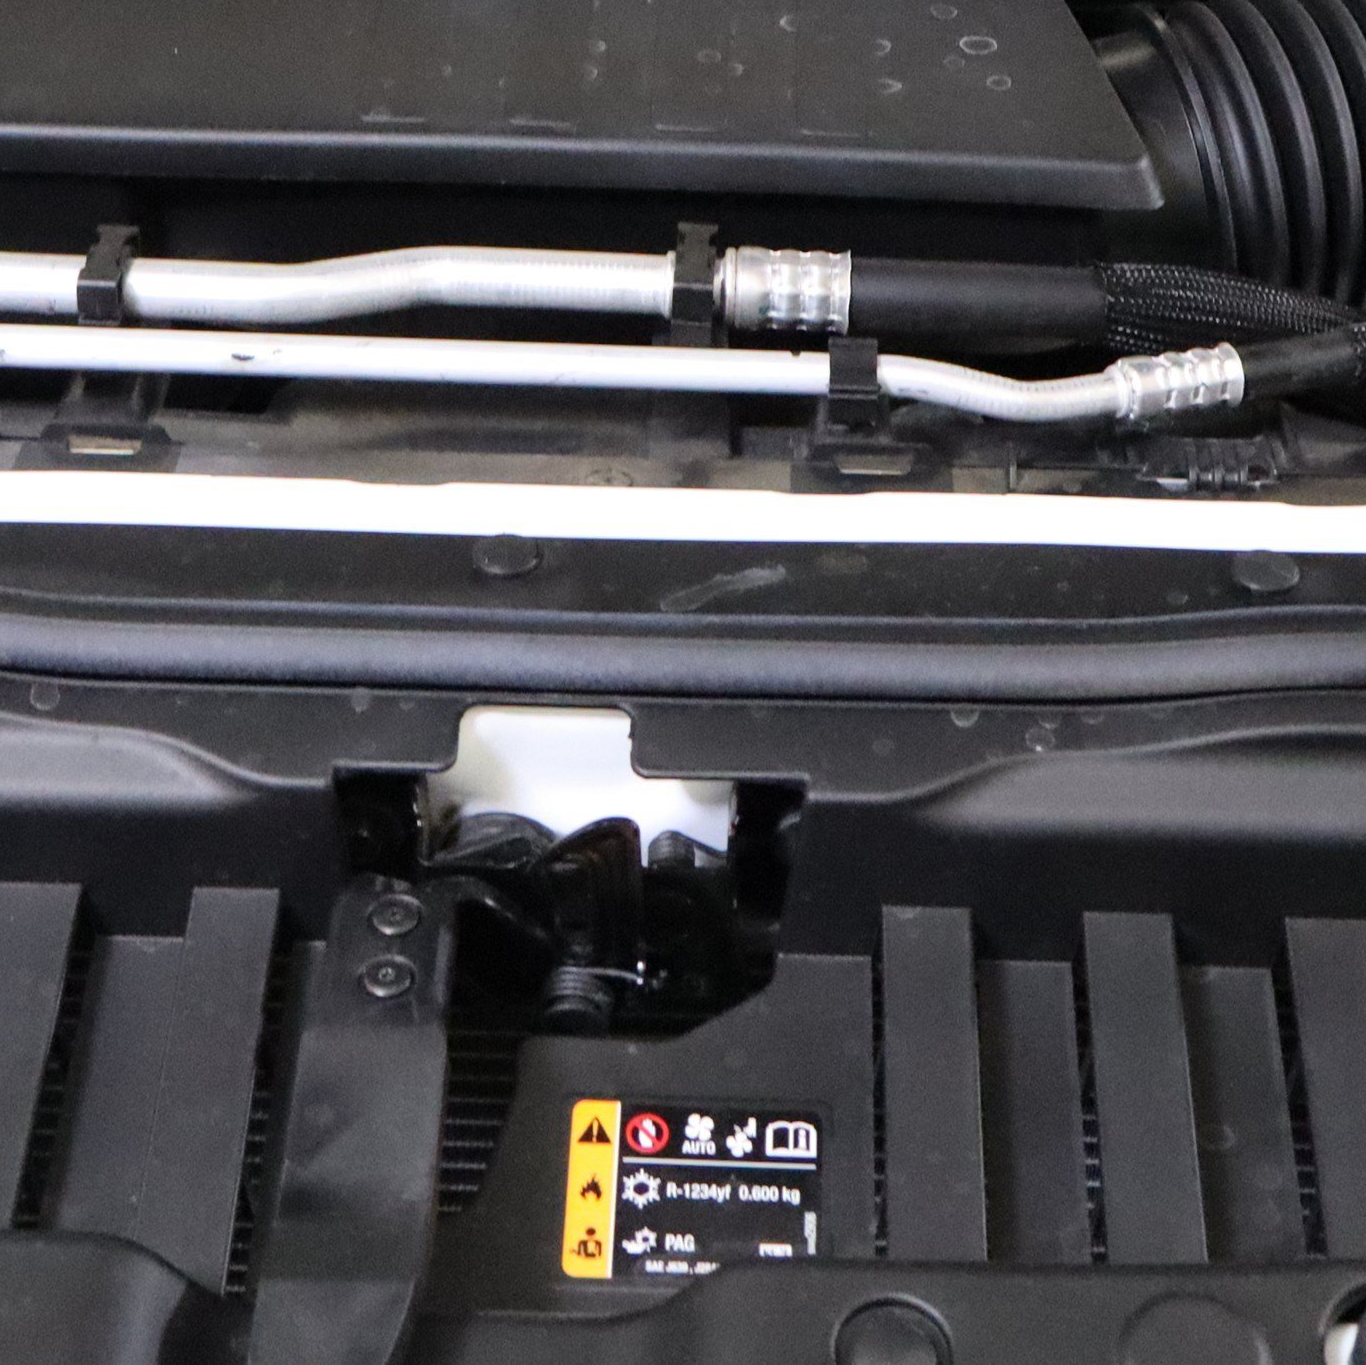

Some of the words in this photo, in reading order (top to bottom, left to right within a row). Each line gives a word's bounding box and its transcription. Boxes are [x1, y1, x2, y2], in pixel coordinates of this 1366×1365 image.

[682, 1142, 716, 1155] AUTO
[665, 1181, 732, 1204] R-1234yf
[781, 1185, 802, 1207] kg
[664, 1233, 696, 1252] PAG
